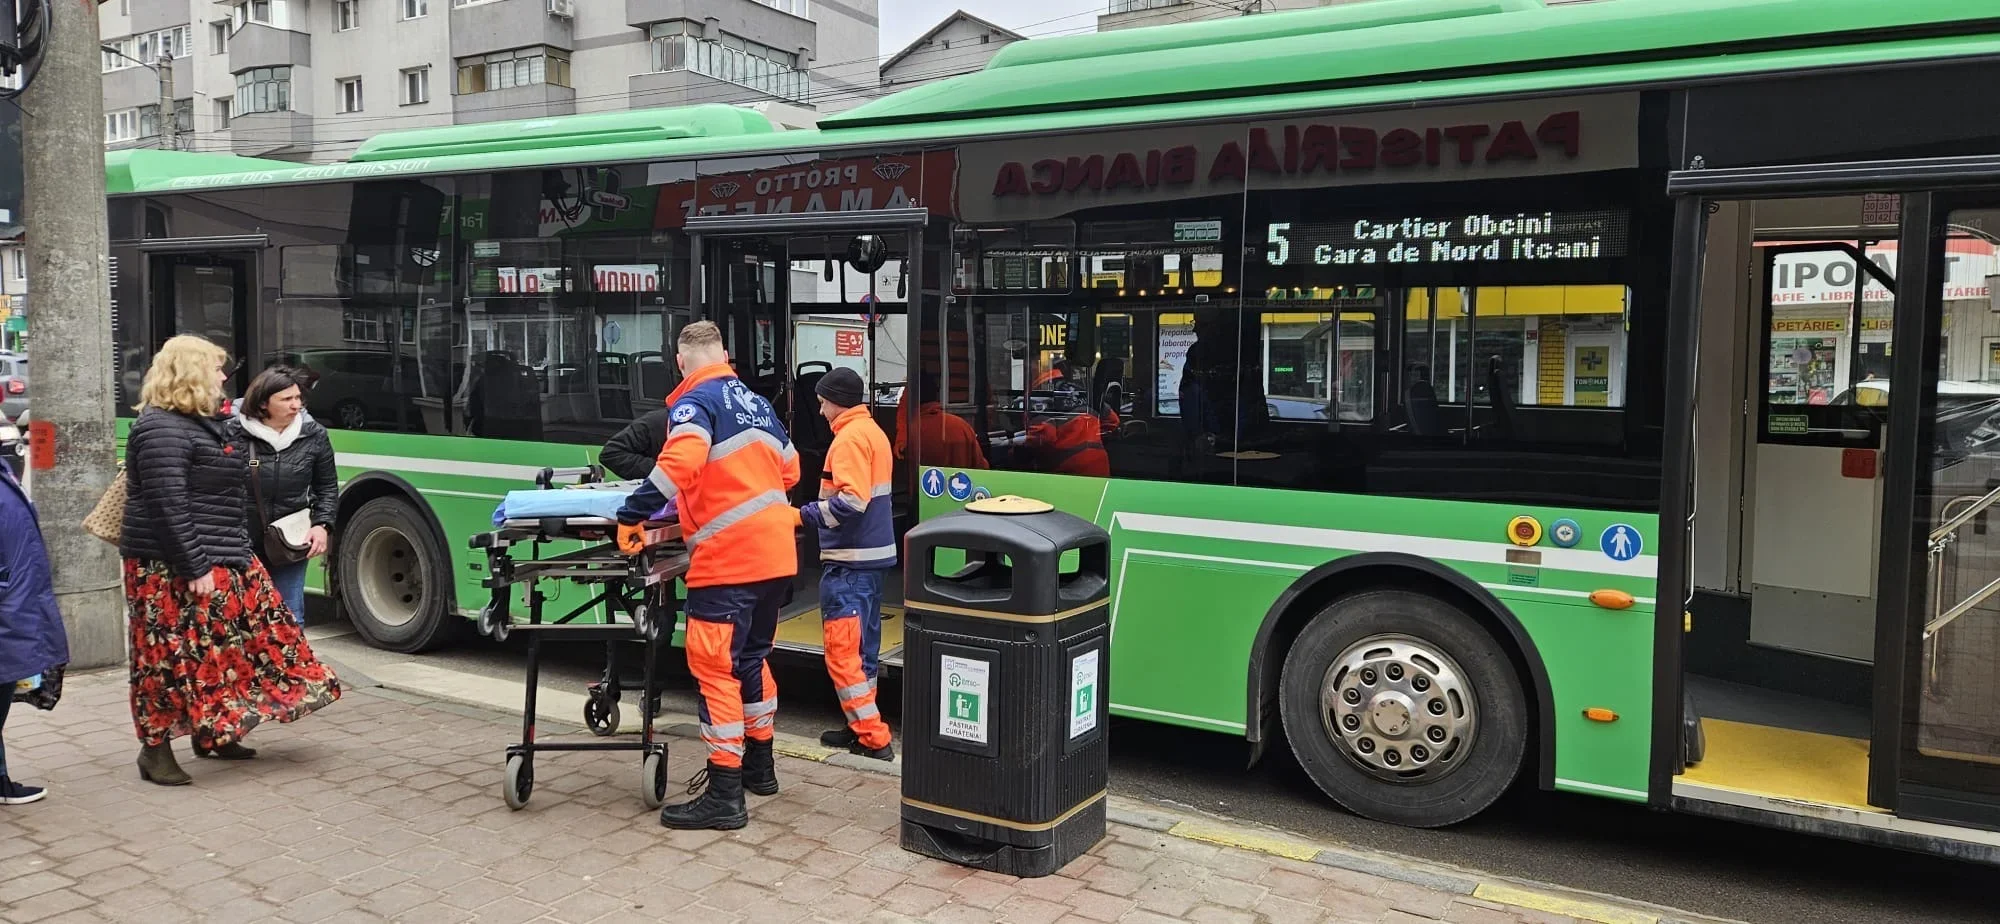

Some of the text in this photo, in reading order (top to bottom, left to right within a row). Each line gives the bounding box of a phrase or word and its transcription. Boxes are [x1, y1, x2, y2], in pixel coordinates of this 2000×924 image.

[292, 164, 337, 180] Zero
[343, 159, 431, 177] Emission
[1353, 216, 1452, 243] Cartier
[1463, 211, 1552, 236] Obcini
[1266, 222, 1291, 266] 5
[1313, 235, 1601, 266] Gara de Nord Itcani
[1772, 286, 1990, 303] AFIE LIBRRIE TĂRIE
[1164, 349, 1187, 360] propri
